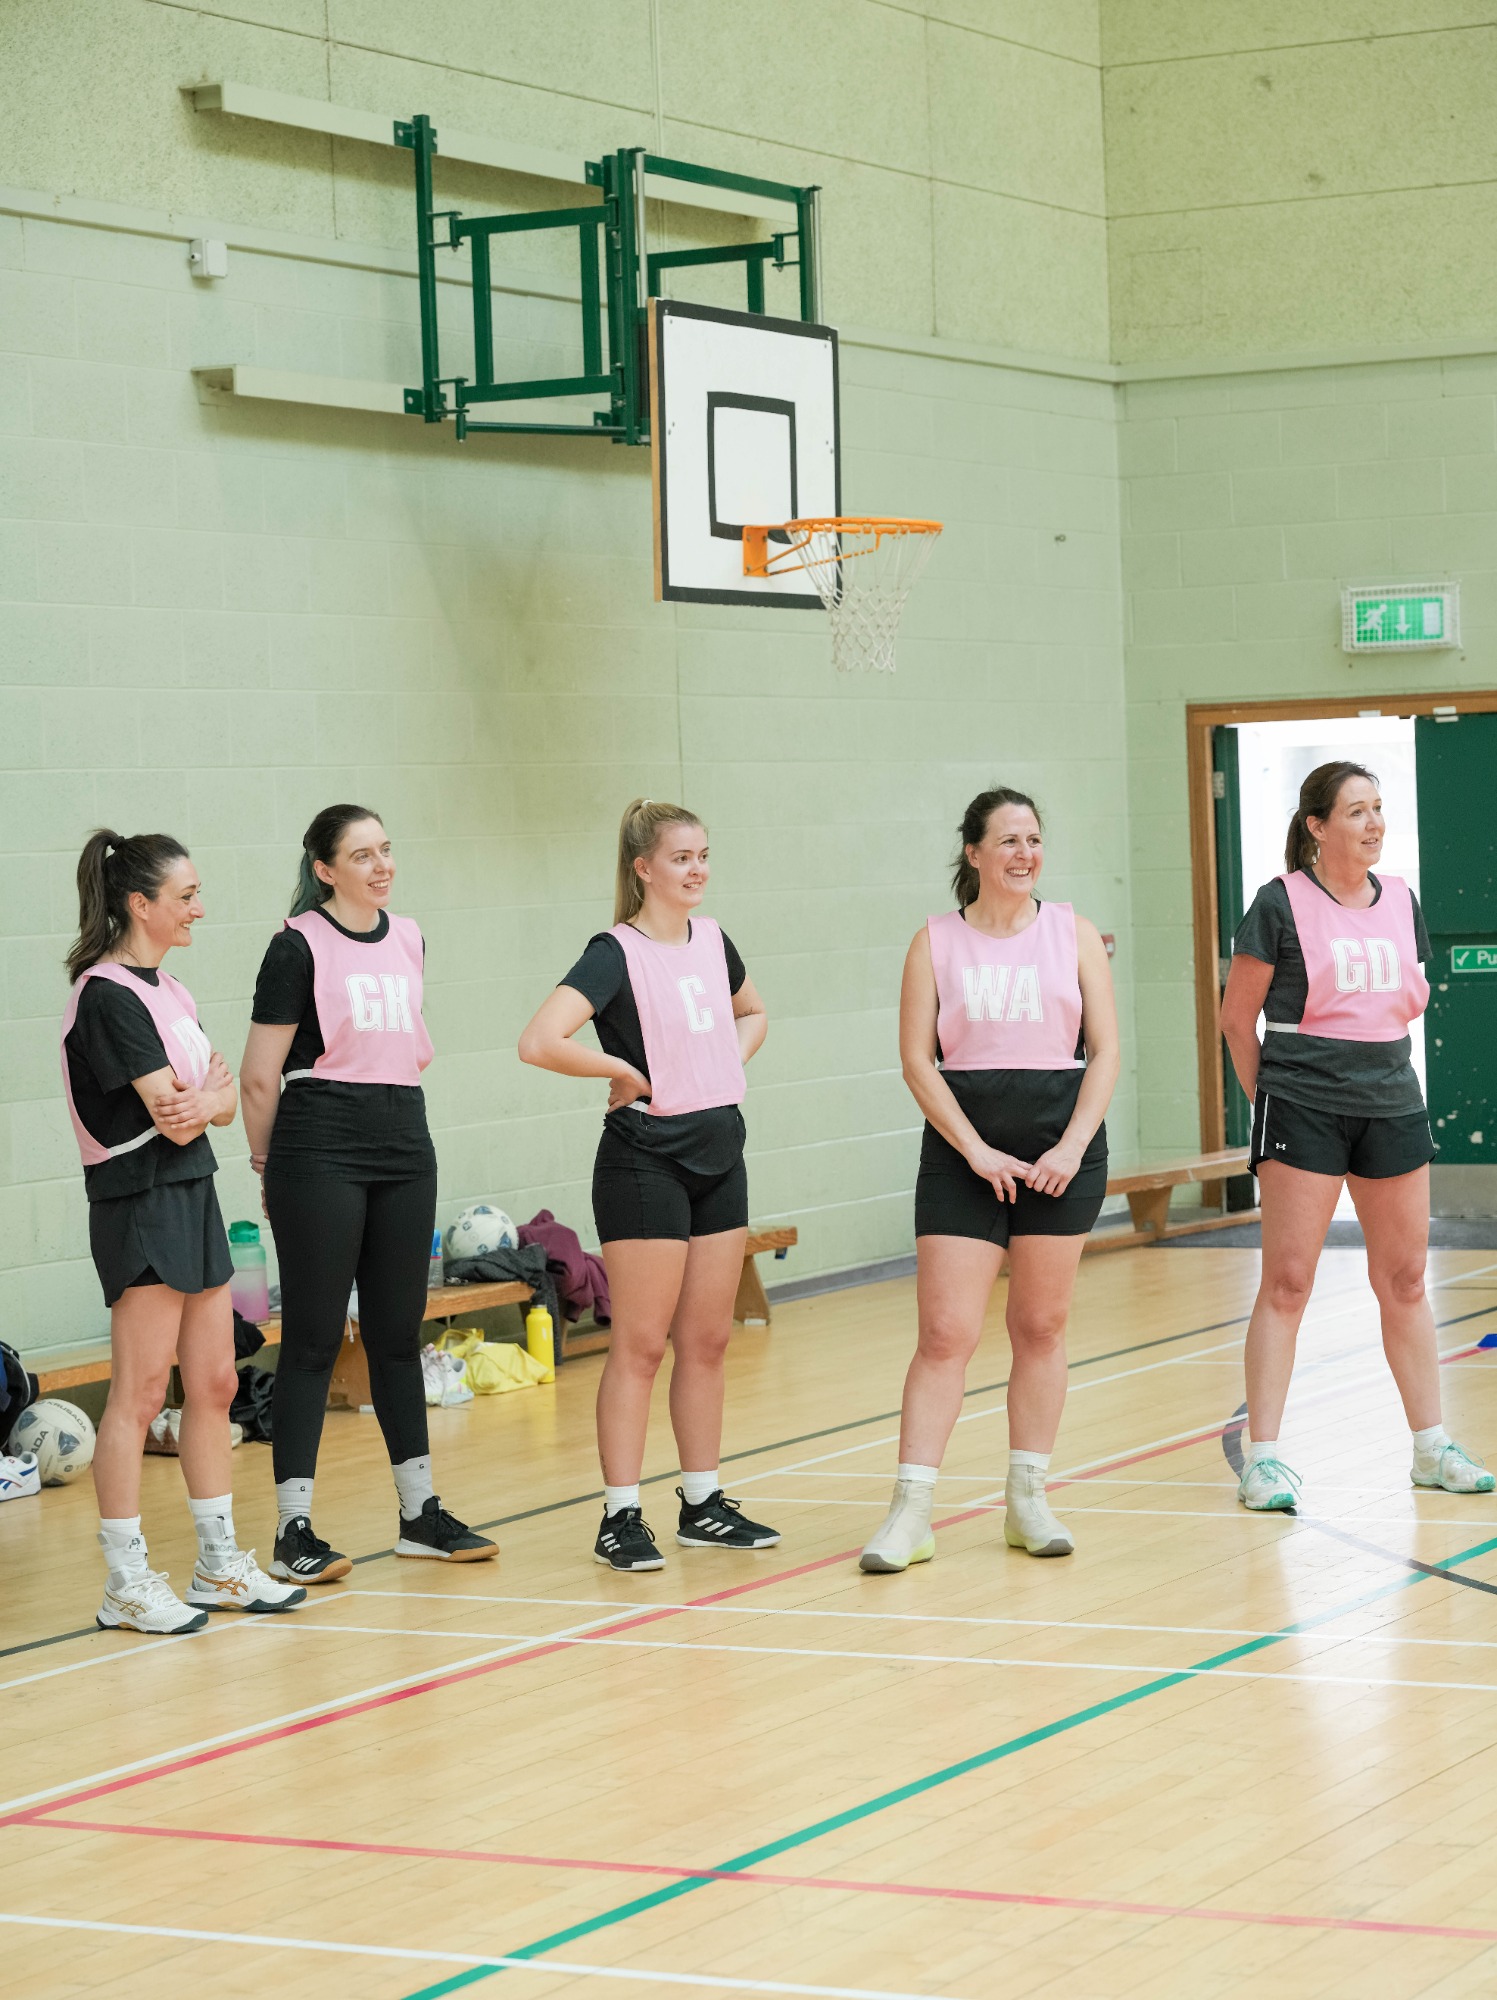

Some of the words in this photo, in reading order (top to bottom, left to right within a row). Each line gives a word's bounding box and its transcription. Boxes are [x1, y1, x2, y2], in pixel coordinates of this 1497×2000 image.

[961, 964, 1044, 1023] WA
[1330, 937, 1402, 993] GD
[345, 974, 414, 1033] GK
[677, 974, 715, 1034] C
[46, 1401, 87, 1432] KRUSADA
